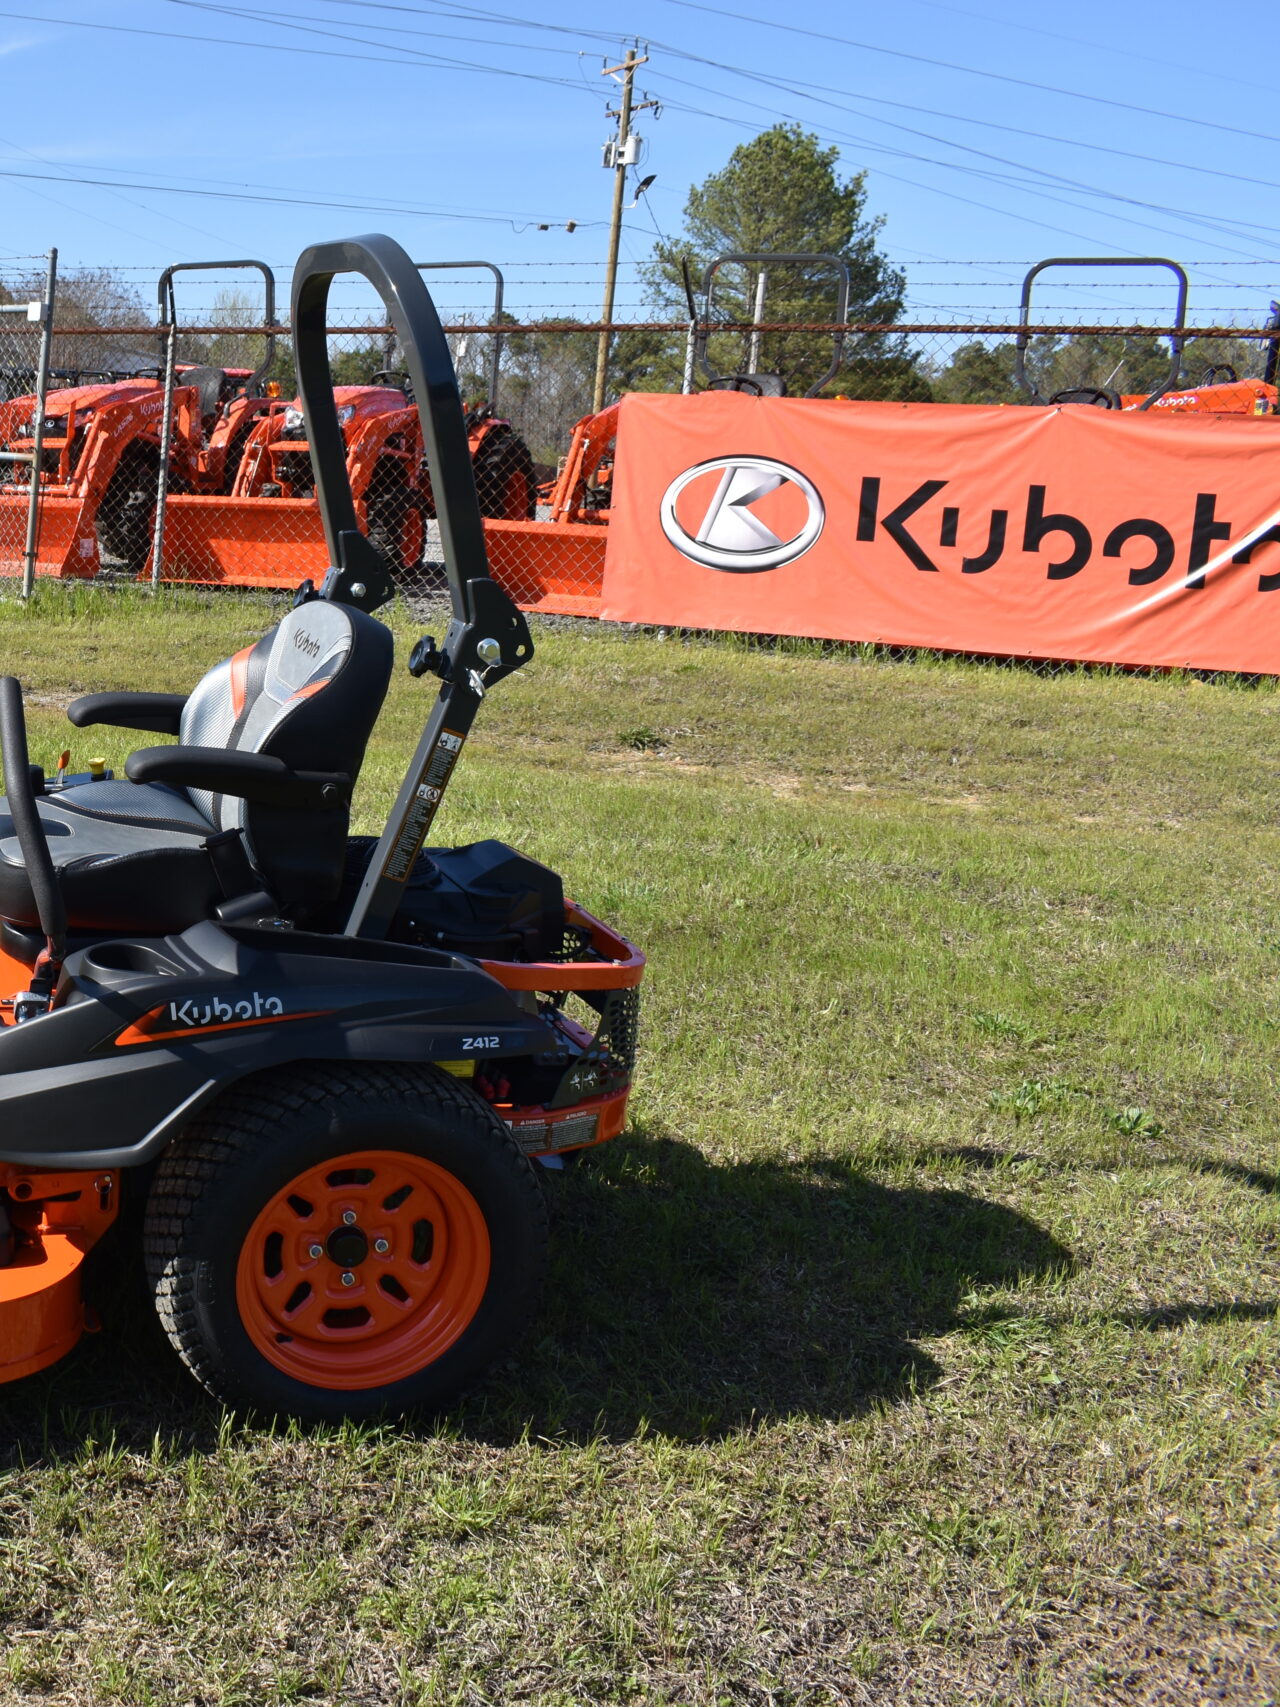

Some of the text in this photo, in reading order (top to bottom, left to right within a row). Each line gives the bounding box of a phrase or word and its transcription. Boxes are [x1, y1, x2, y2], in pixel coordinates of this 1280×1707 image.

[140, 398, 164, 416] Kubot
[293, 628, 320, 658] Kubota
[170, 991, 284, 1026] Kubota
[462, 1036, 500, 1050] Z412
